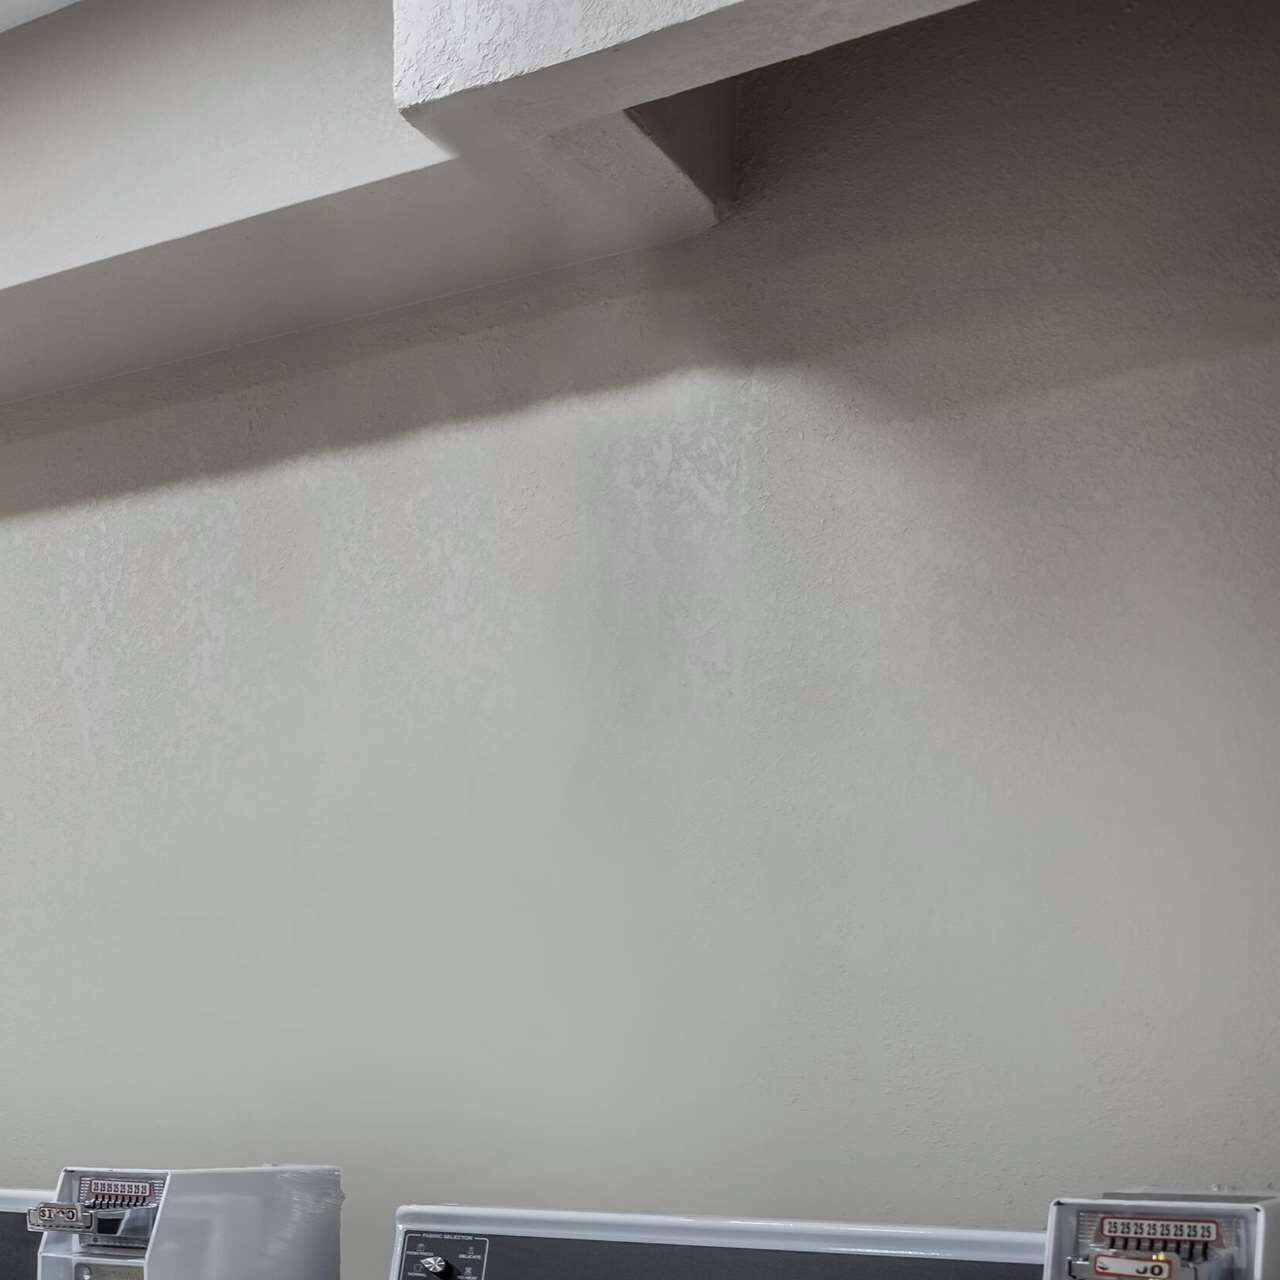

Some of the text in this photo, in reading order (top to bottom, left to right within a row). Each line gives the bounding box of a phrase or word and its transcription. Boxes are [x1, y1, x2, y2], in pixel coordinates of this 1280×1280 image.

[1107, 1221, 1211, 1238] 25 25 25 25 25 25 25 25
